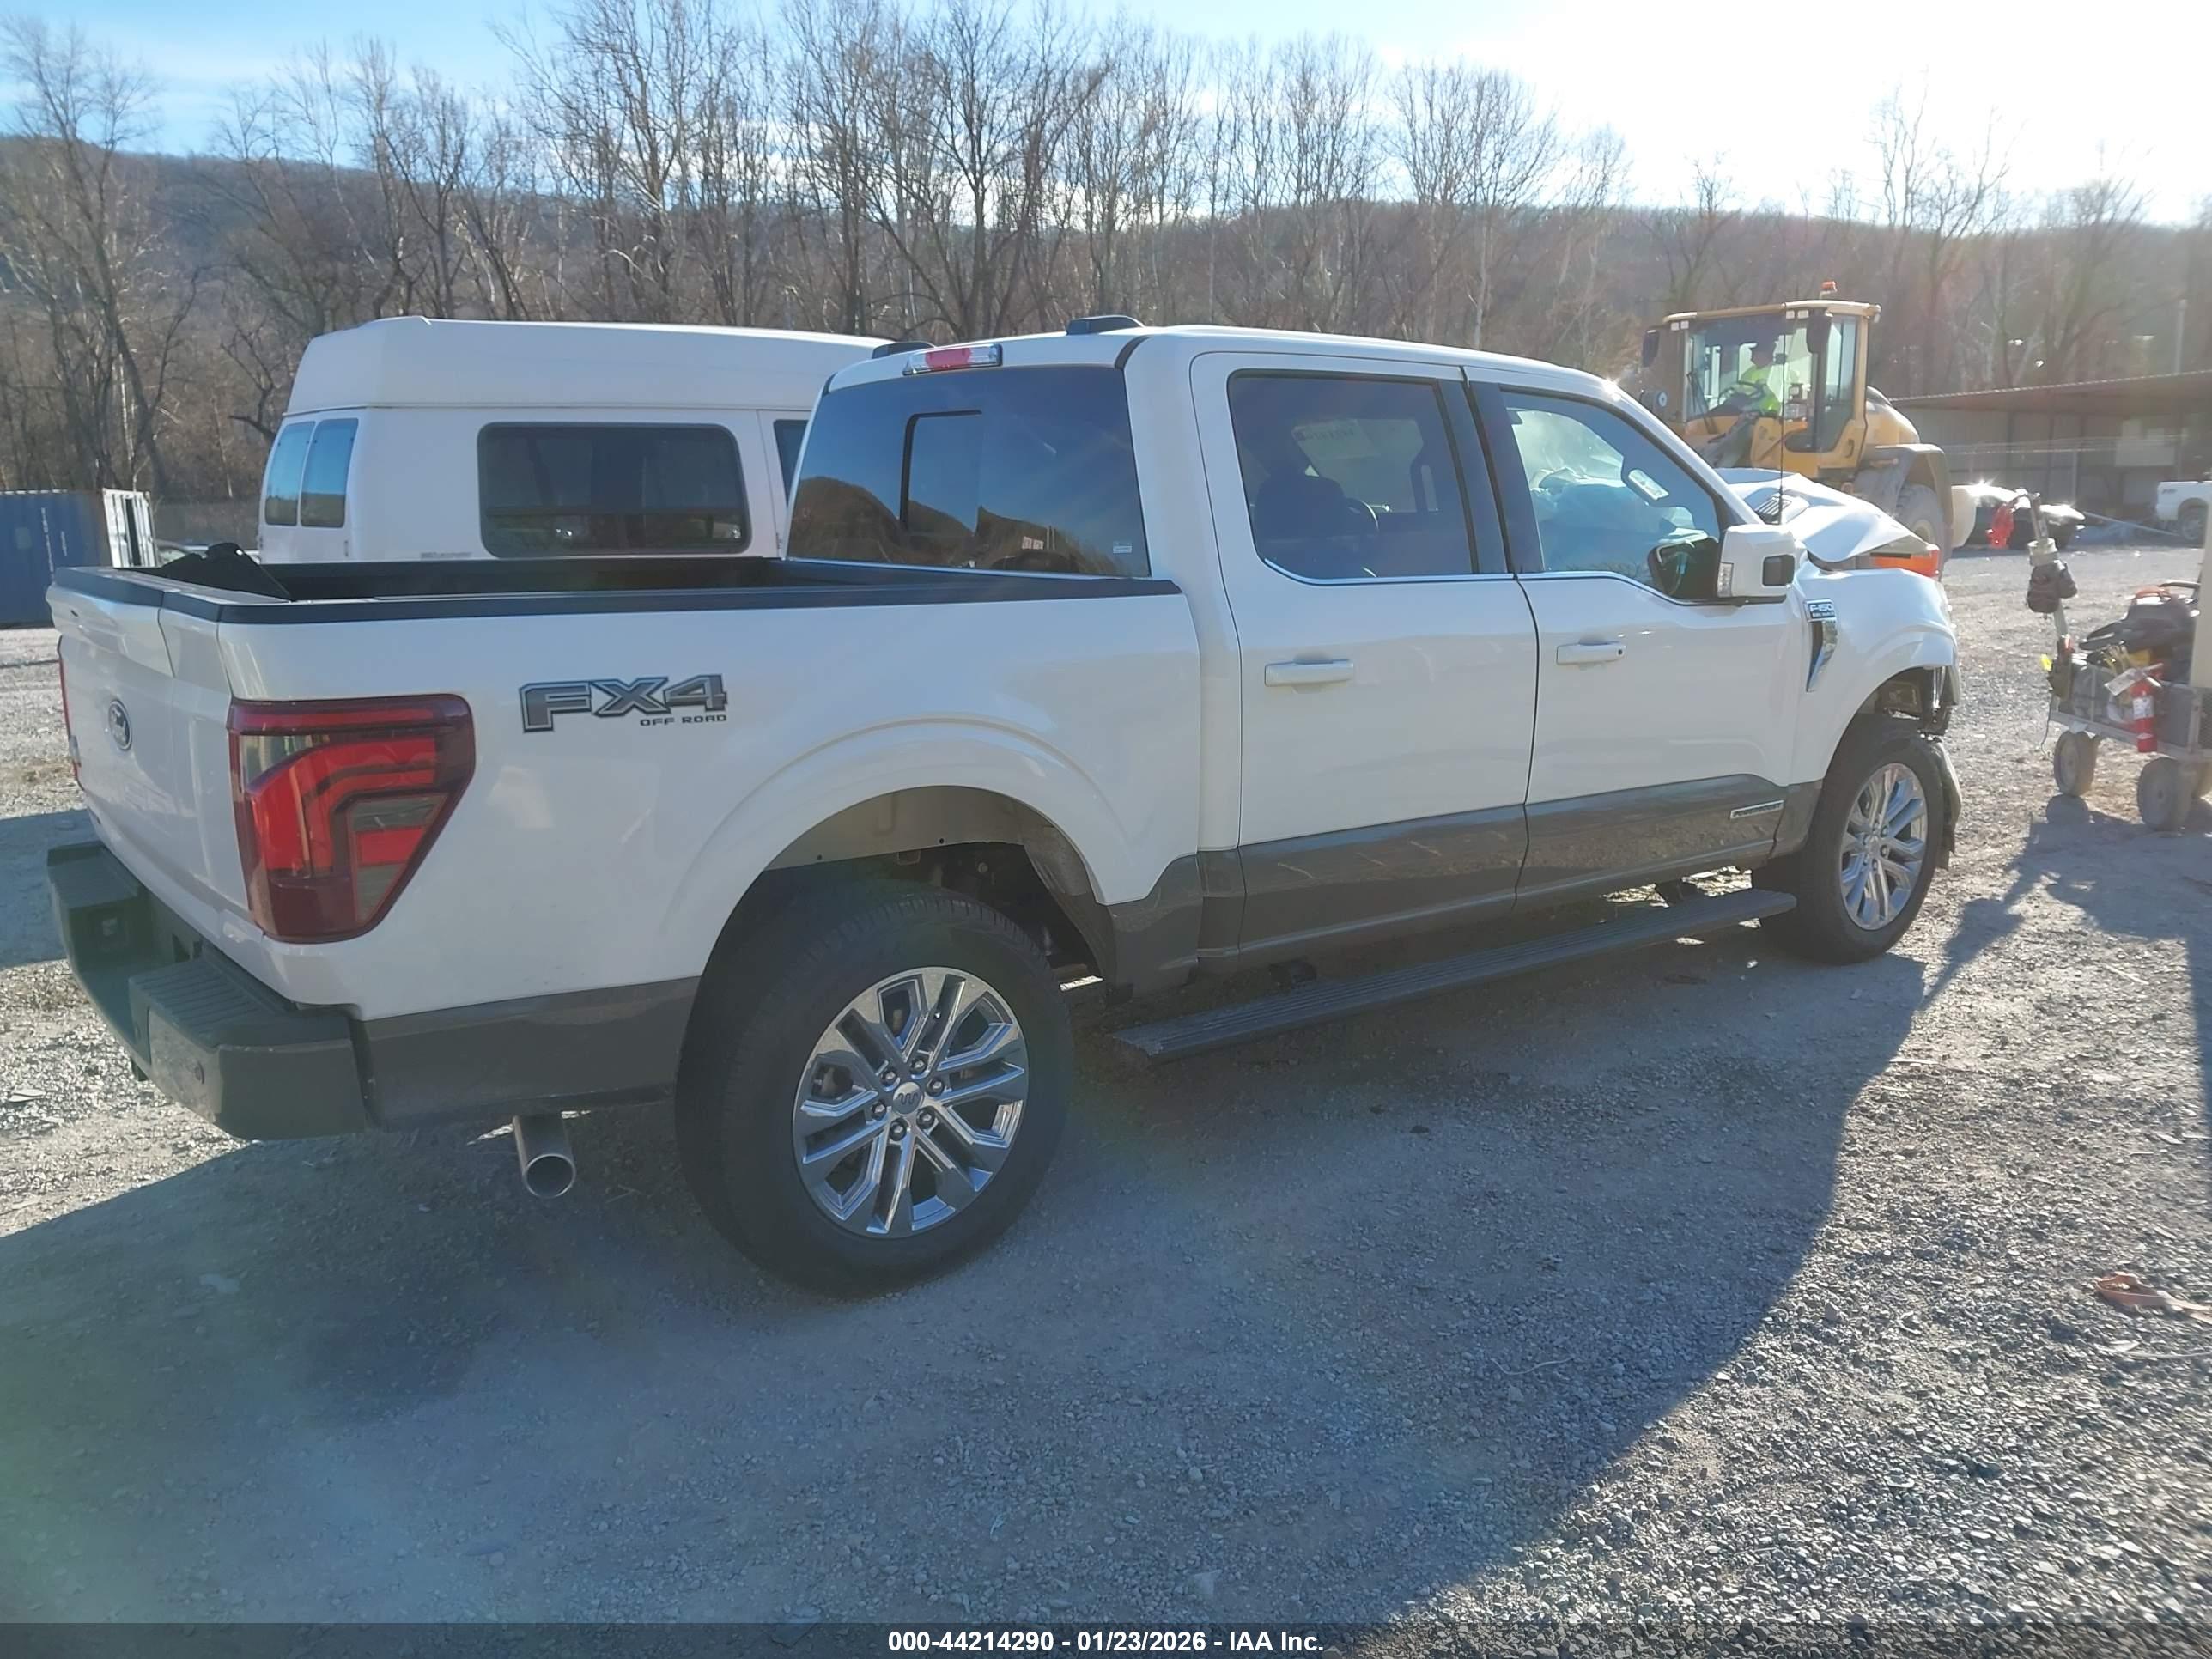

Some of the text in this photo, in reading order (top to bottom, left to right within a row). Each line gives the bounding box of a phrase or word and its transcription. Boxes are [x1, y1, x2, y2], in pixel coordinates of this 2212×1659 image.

[519, 673, 727, 733] FX4
[640, 714, 727, 726] OFF ROAD
